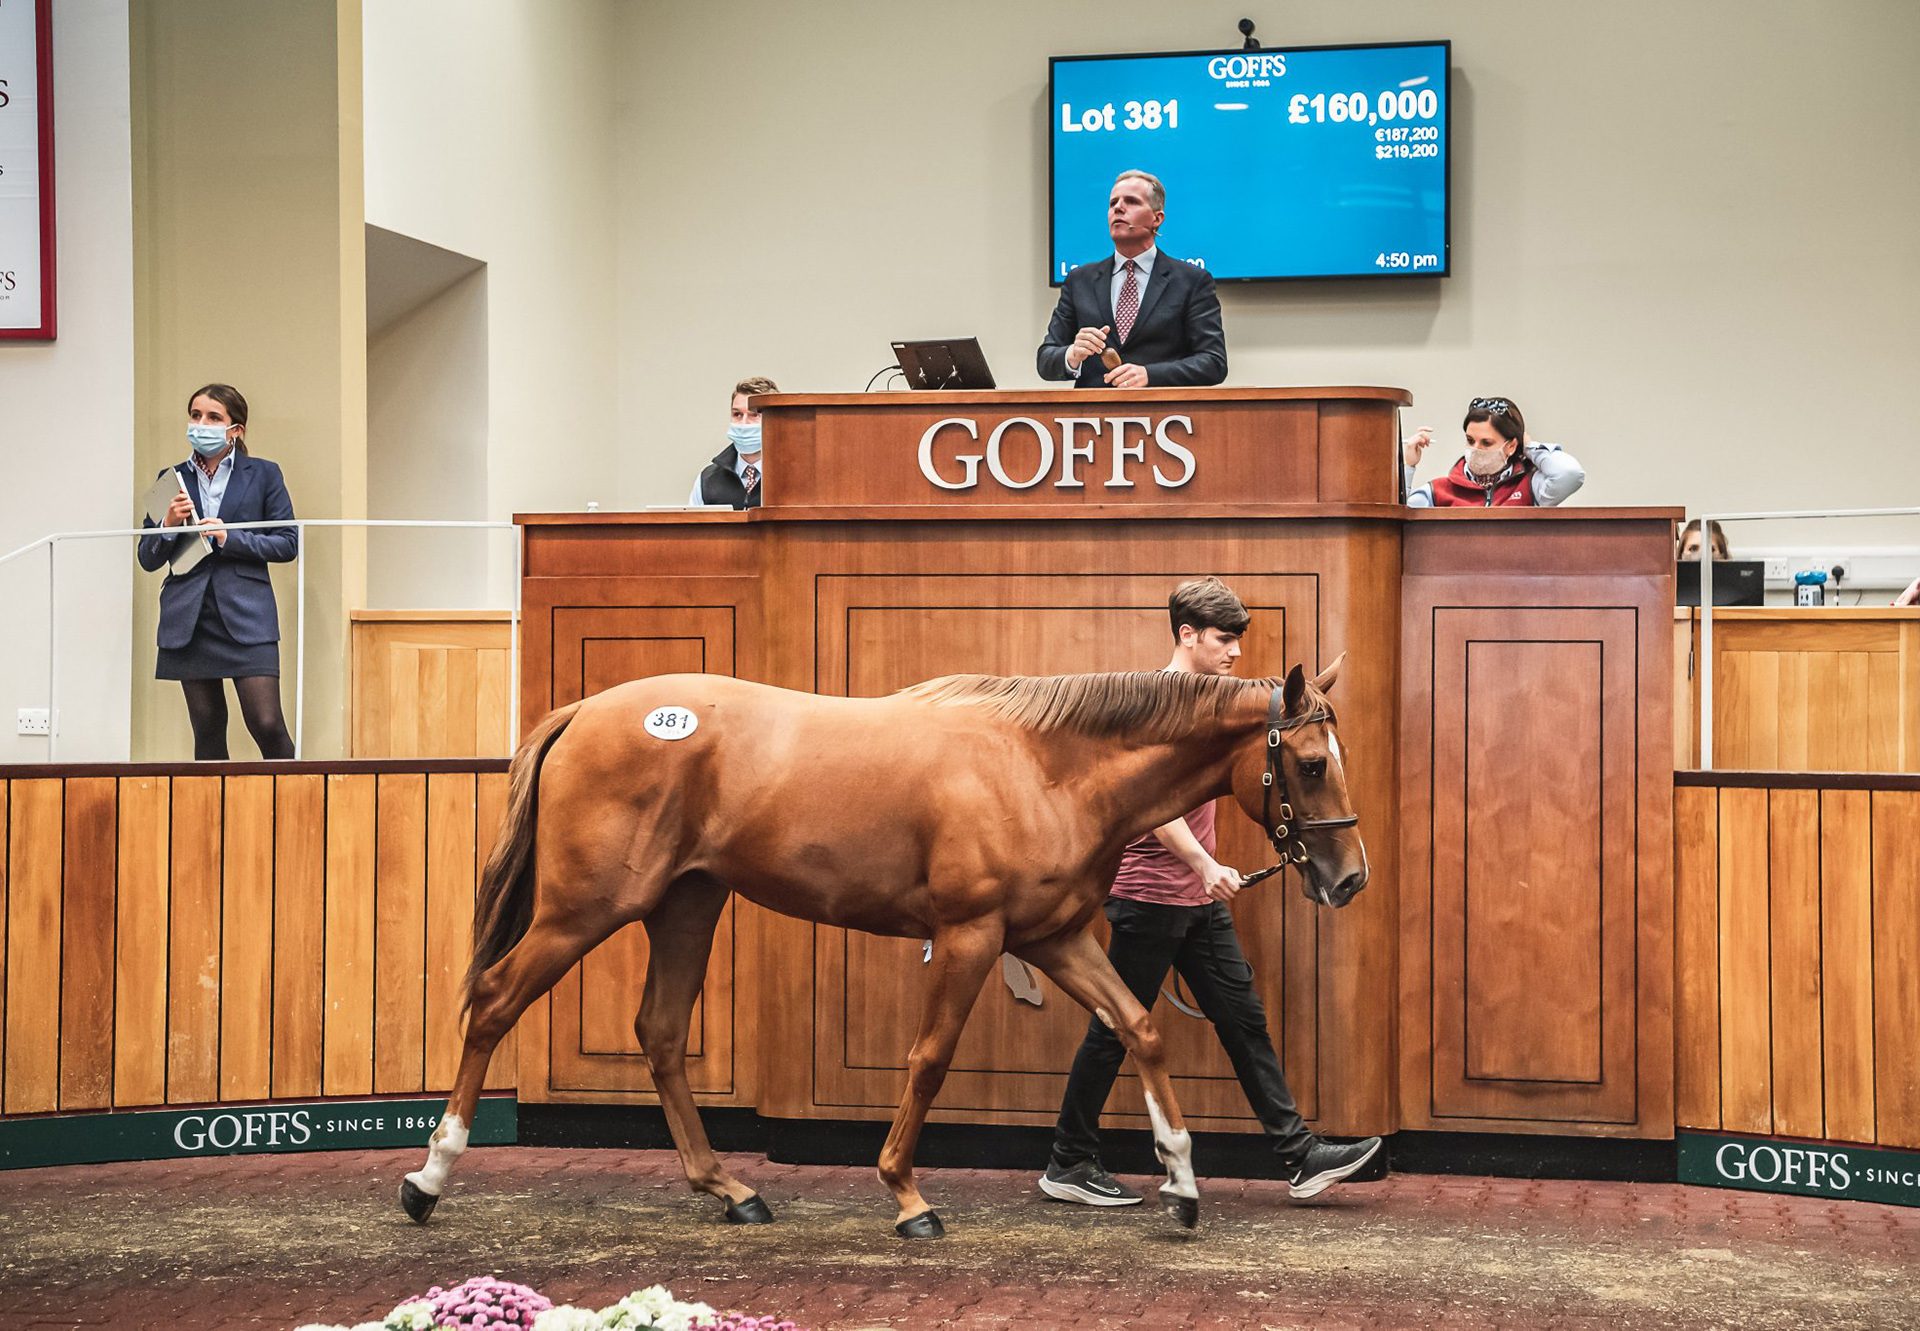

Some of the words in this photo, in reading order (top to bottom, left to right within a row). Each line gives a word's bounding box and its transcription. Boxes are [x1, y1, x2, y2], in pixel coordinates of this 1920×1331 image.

[1208, 54, 1287, 80] GOFFS
[1061, 102, 1116, 132] Lot
[1123, 98, 1178, 131] 381
[1287, 89, 1438, 127] £160,000
[1374, 126, 1438, 143] €187,200
[1375, 143, 1438, 160] $219,200
[1375, 252, 1410, 268] 4:50
[1413, 254, 1438, 270] pm
[917, 414, 1196, 490] GOFFS
[652, 712, 689, 729] 381
[173, 1110, 311, 1150] GOFFS
[326, 1118, 384, 1132] SINCE
[397, 1116, 437, 1129] 1866
[1715, 1143, 1851, 1190] GOFFS
